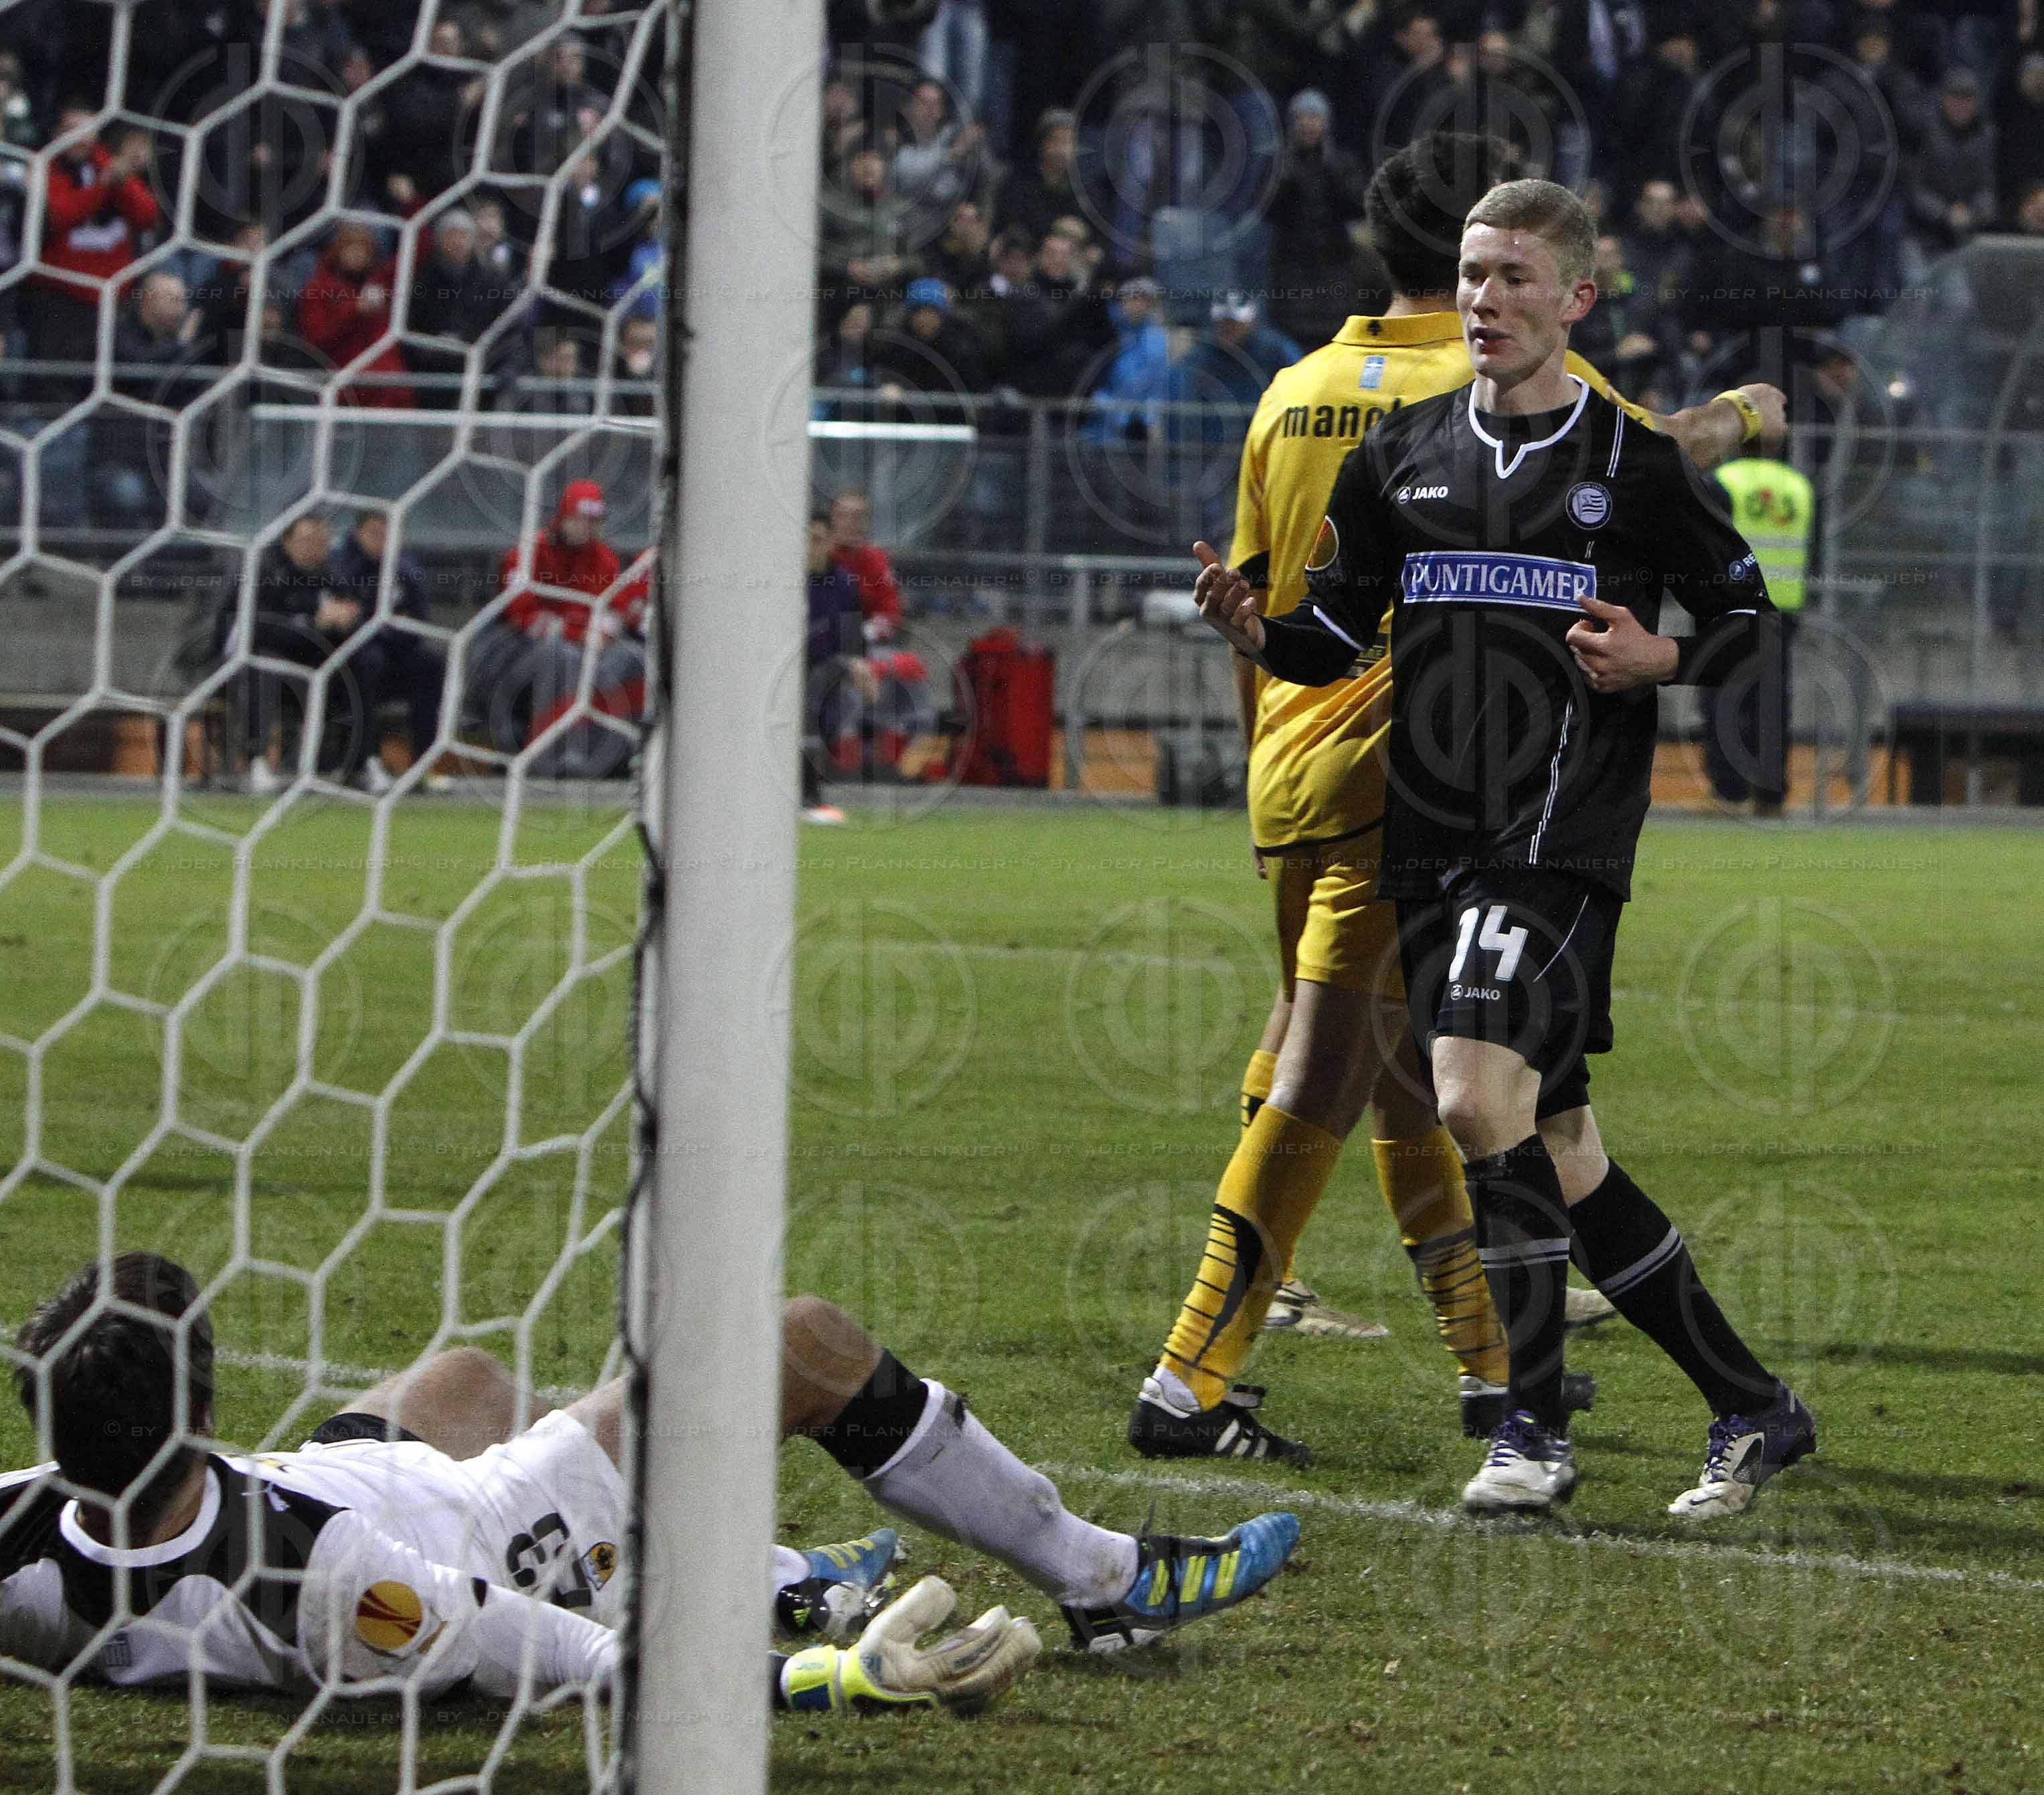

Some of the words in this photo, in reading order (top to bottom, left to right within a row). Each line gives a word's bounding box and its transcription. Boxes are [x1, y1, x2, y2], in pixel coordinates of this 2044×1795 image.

[1284, 398, 1401, 437] mano
[1412, 486, 1449, 500] JAKO
[1410, 563, 1589, 601] PUNTIGAMER
[1448, 905, 1529, 982] 14
[1464, 987, 1501, 1001] JAKO
